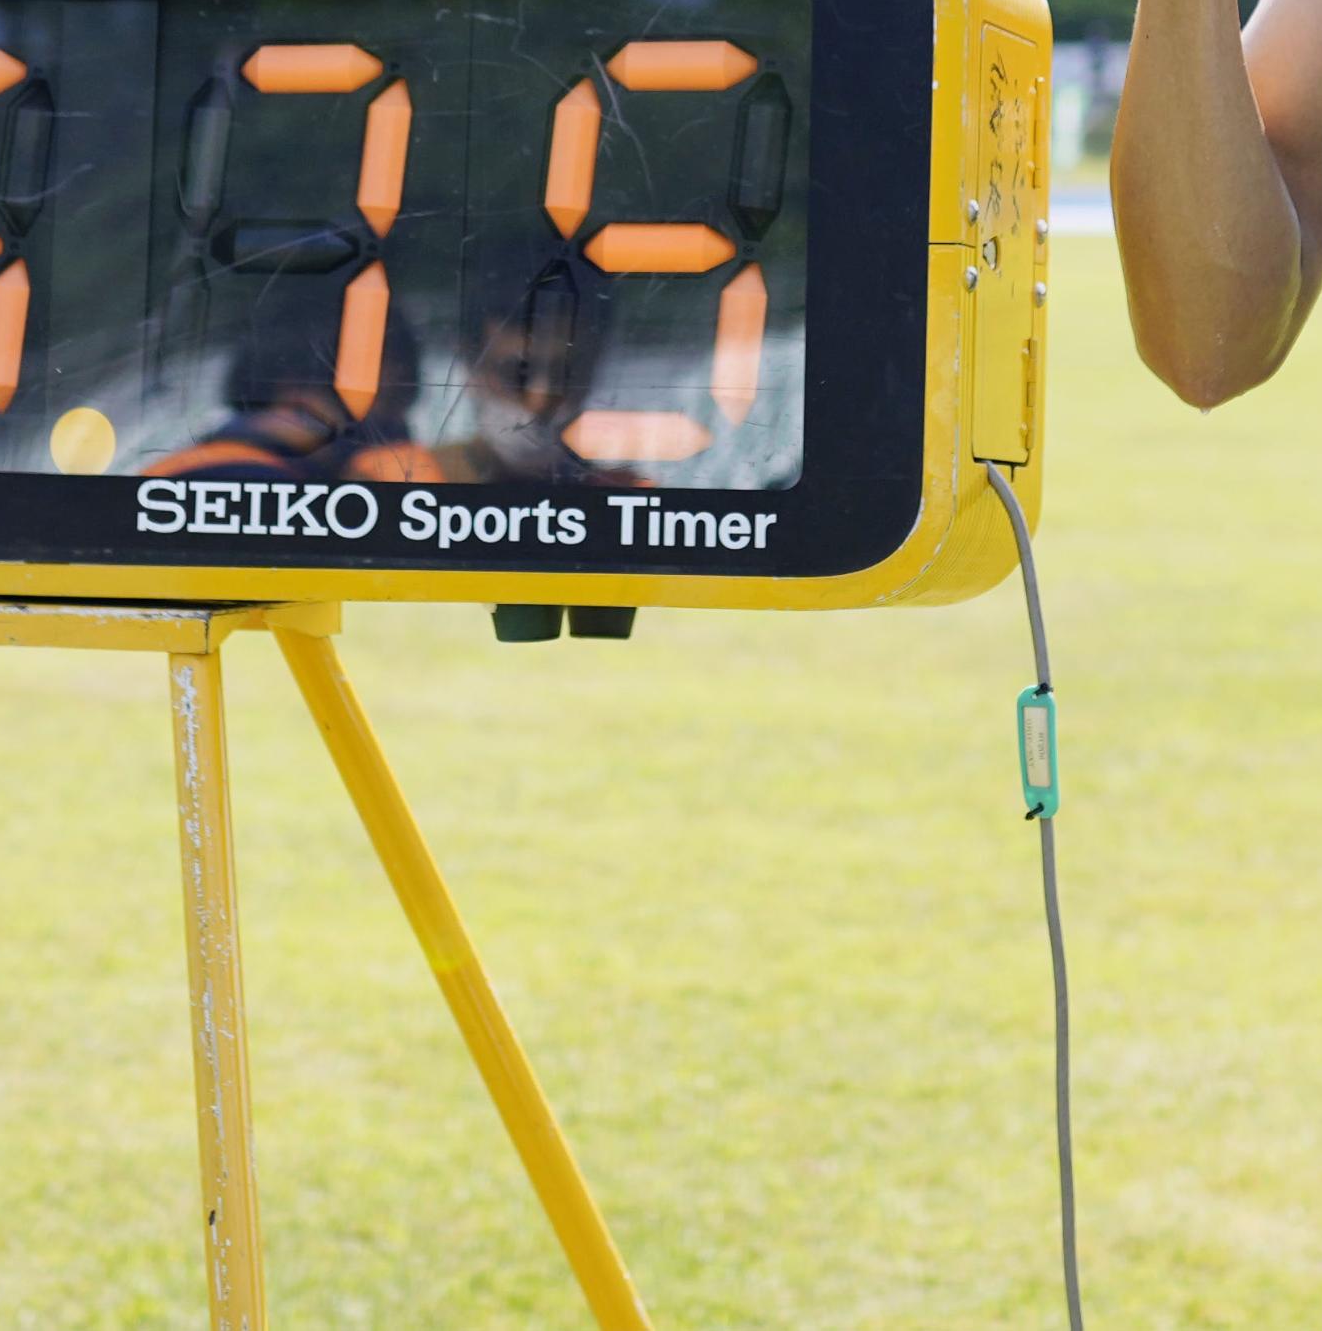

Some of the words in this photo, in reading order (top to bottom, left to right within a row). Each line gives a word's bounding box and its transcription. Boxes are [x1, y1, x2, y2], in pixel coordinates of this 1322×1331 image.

[135, 478, 379, 540] SEIKO
[399, 489, 588, 550] Sports
[606, 495, 778, 551] Timer
